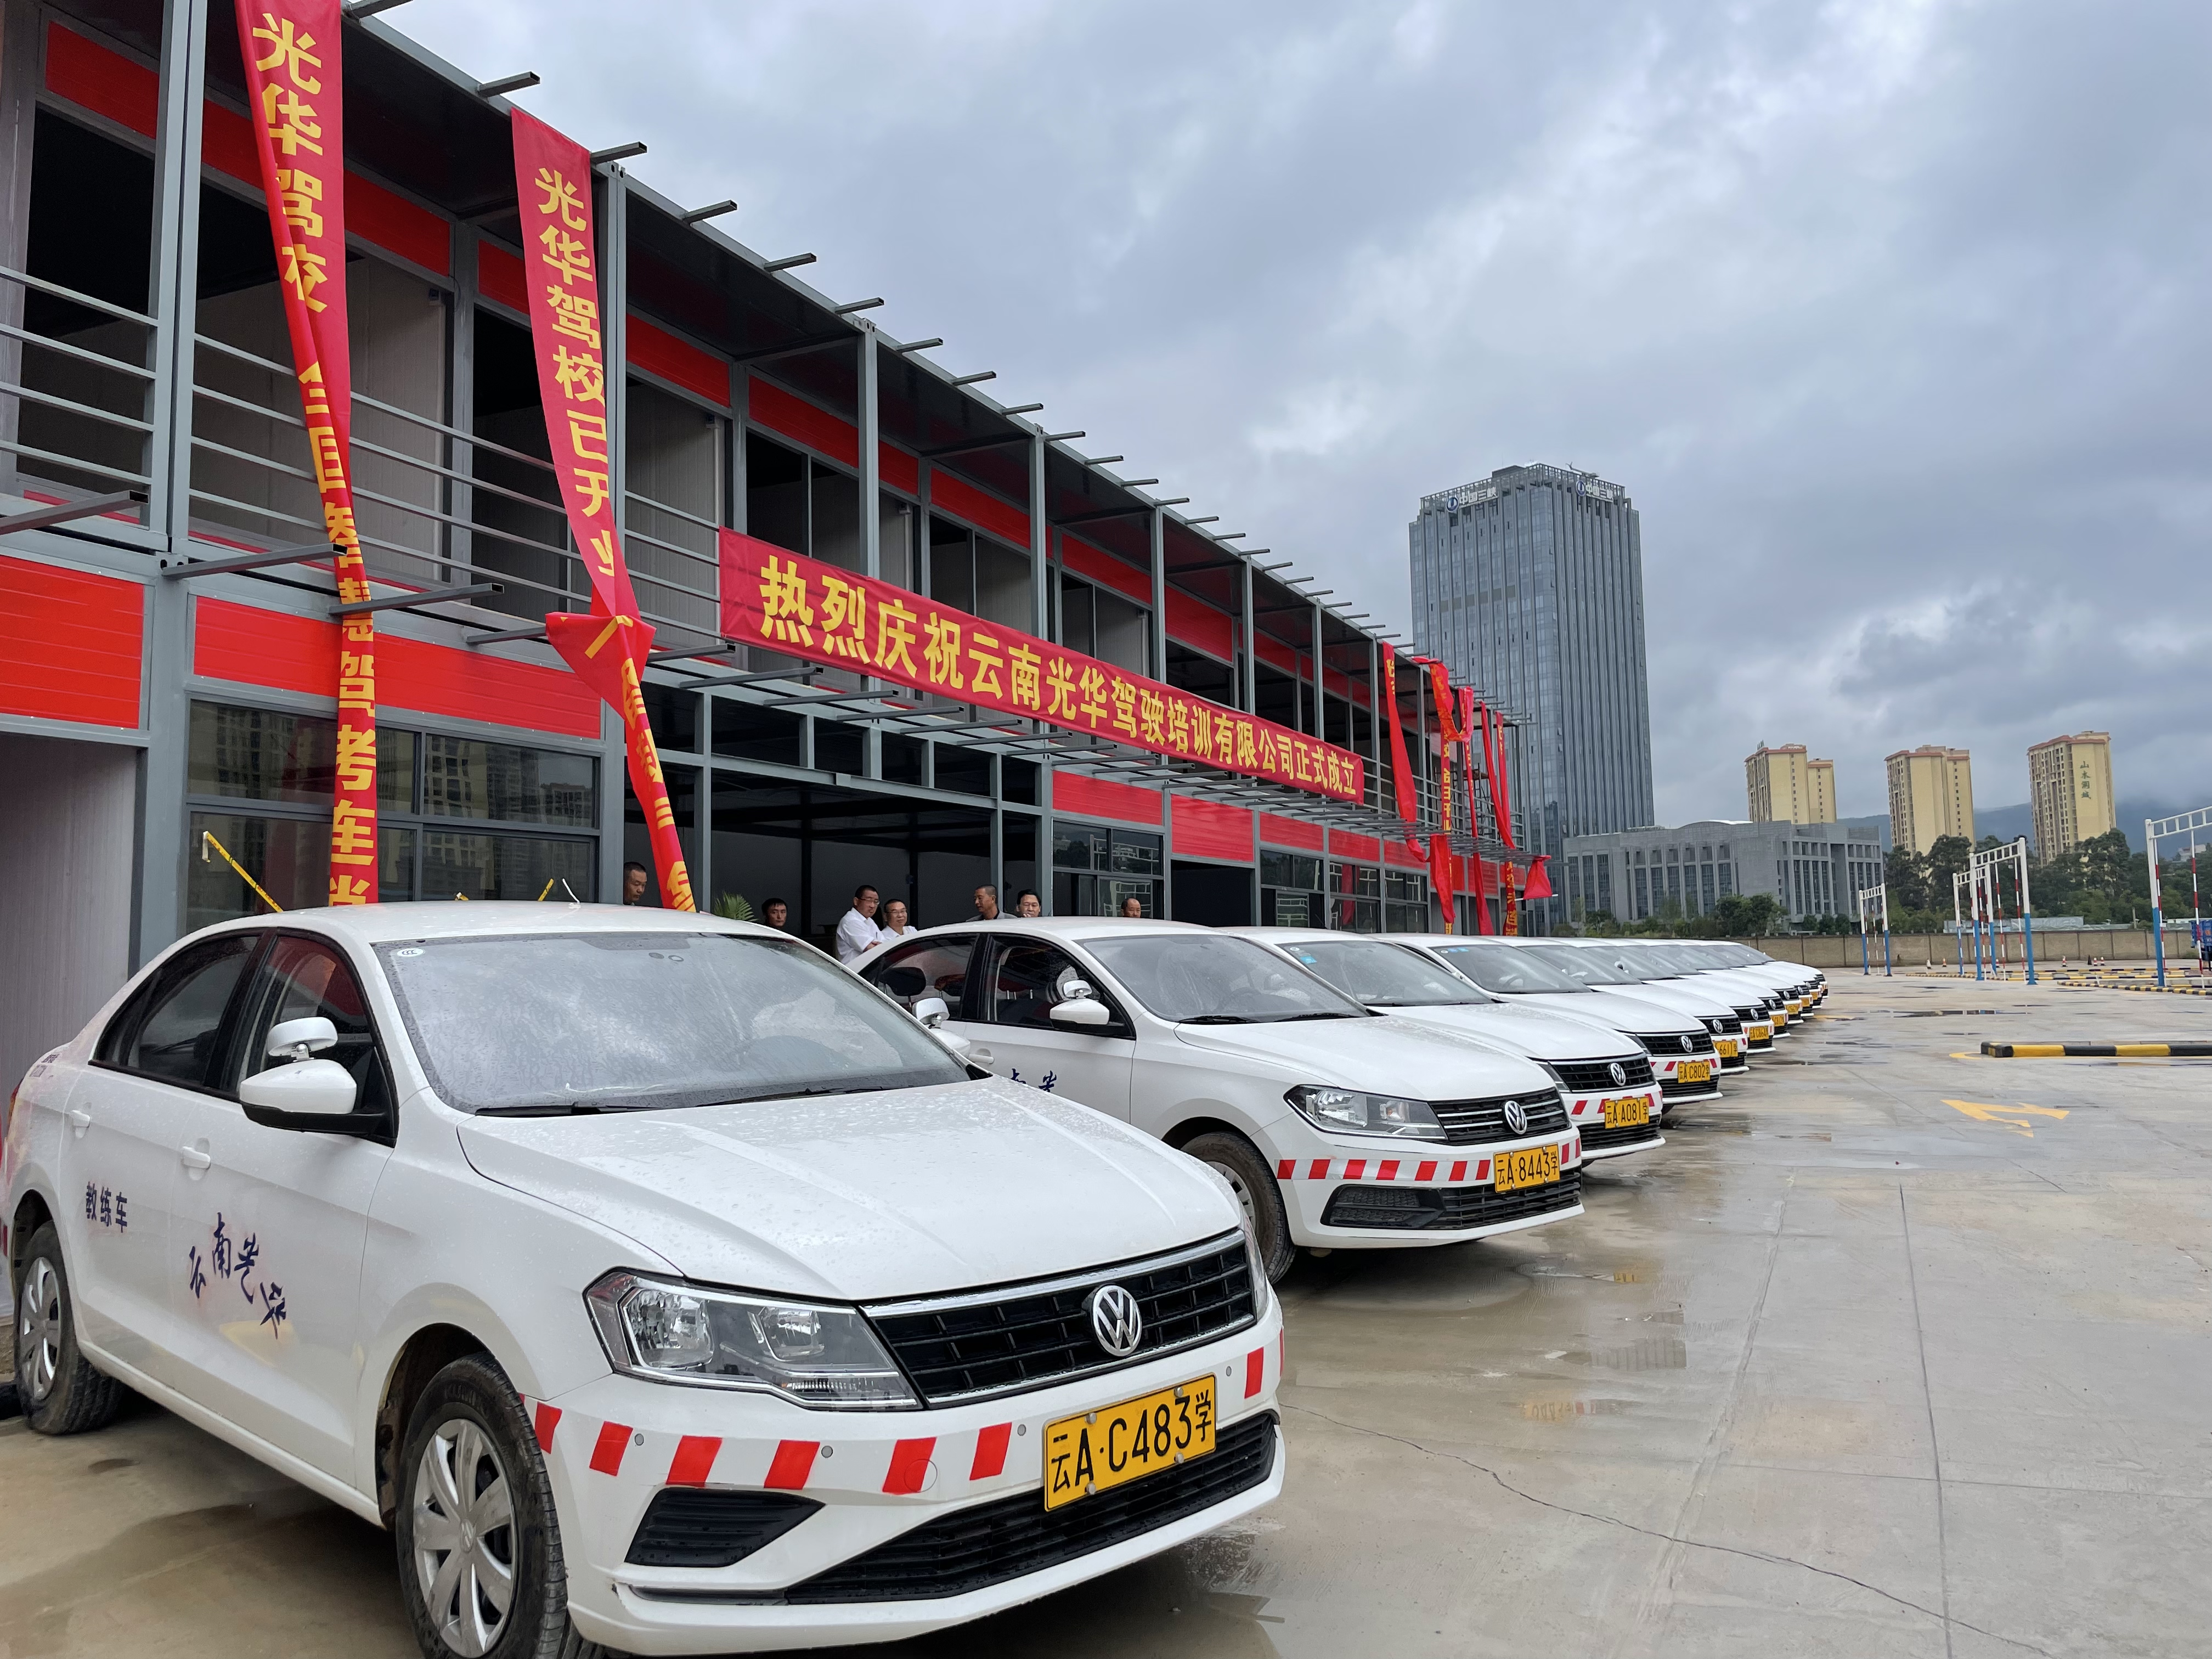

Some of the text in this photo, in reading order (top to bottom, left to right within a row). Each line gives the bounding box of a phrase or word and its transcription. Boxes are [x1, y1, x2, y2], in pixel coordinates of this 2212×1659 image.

[252, 14, 328, 313] 光华驾校
[759, 555, 1356, 795] 热烈庆祝云南光华驾驶培训有限公司正式成立
[86, 1181, 128, 1233] 教练车
[1498, 1150, 1558, 1186] 云A·8443学
[1051, 1389, 1211, 1494] 云A·C483学
